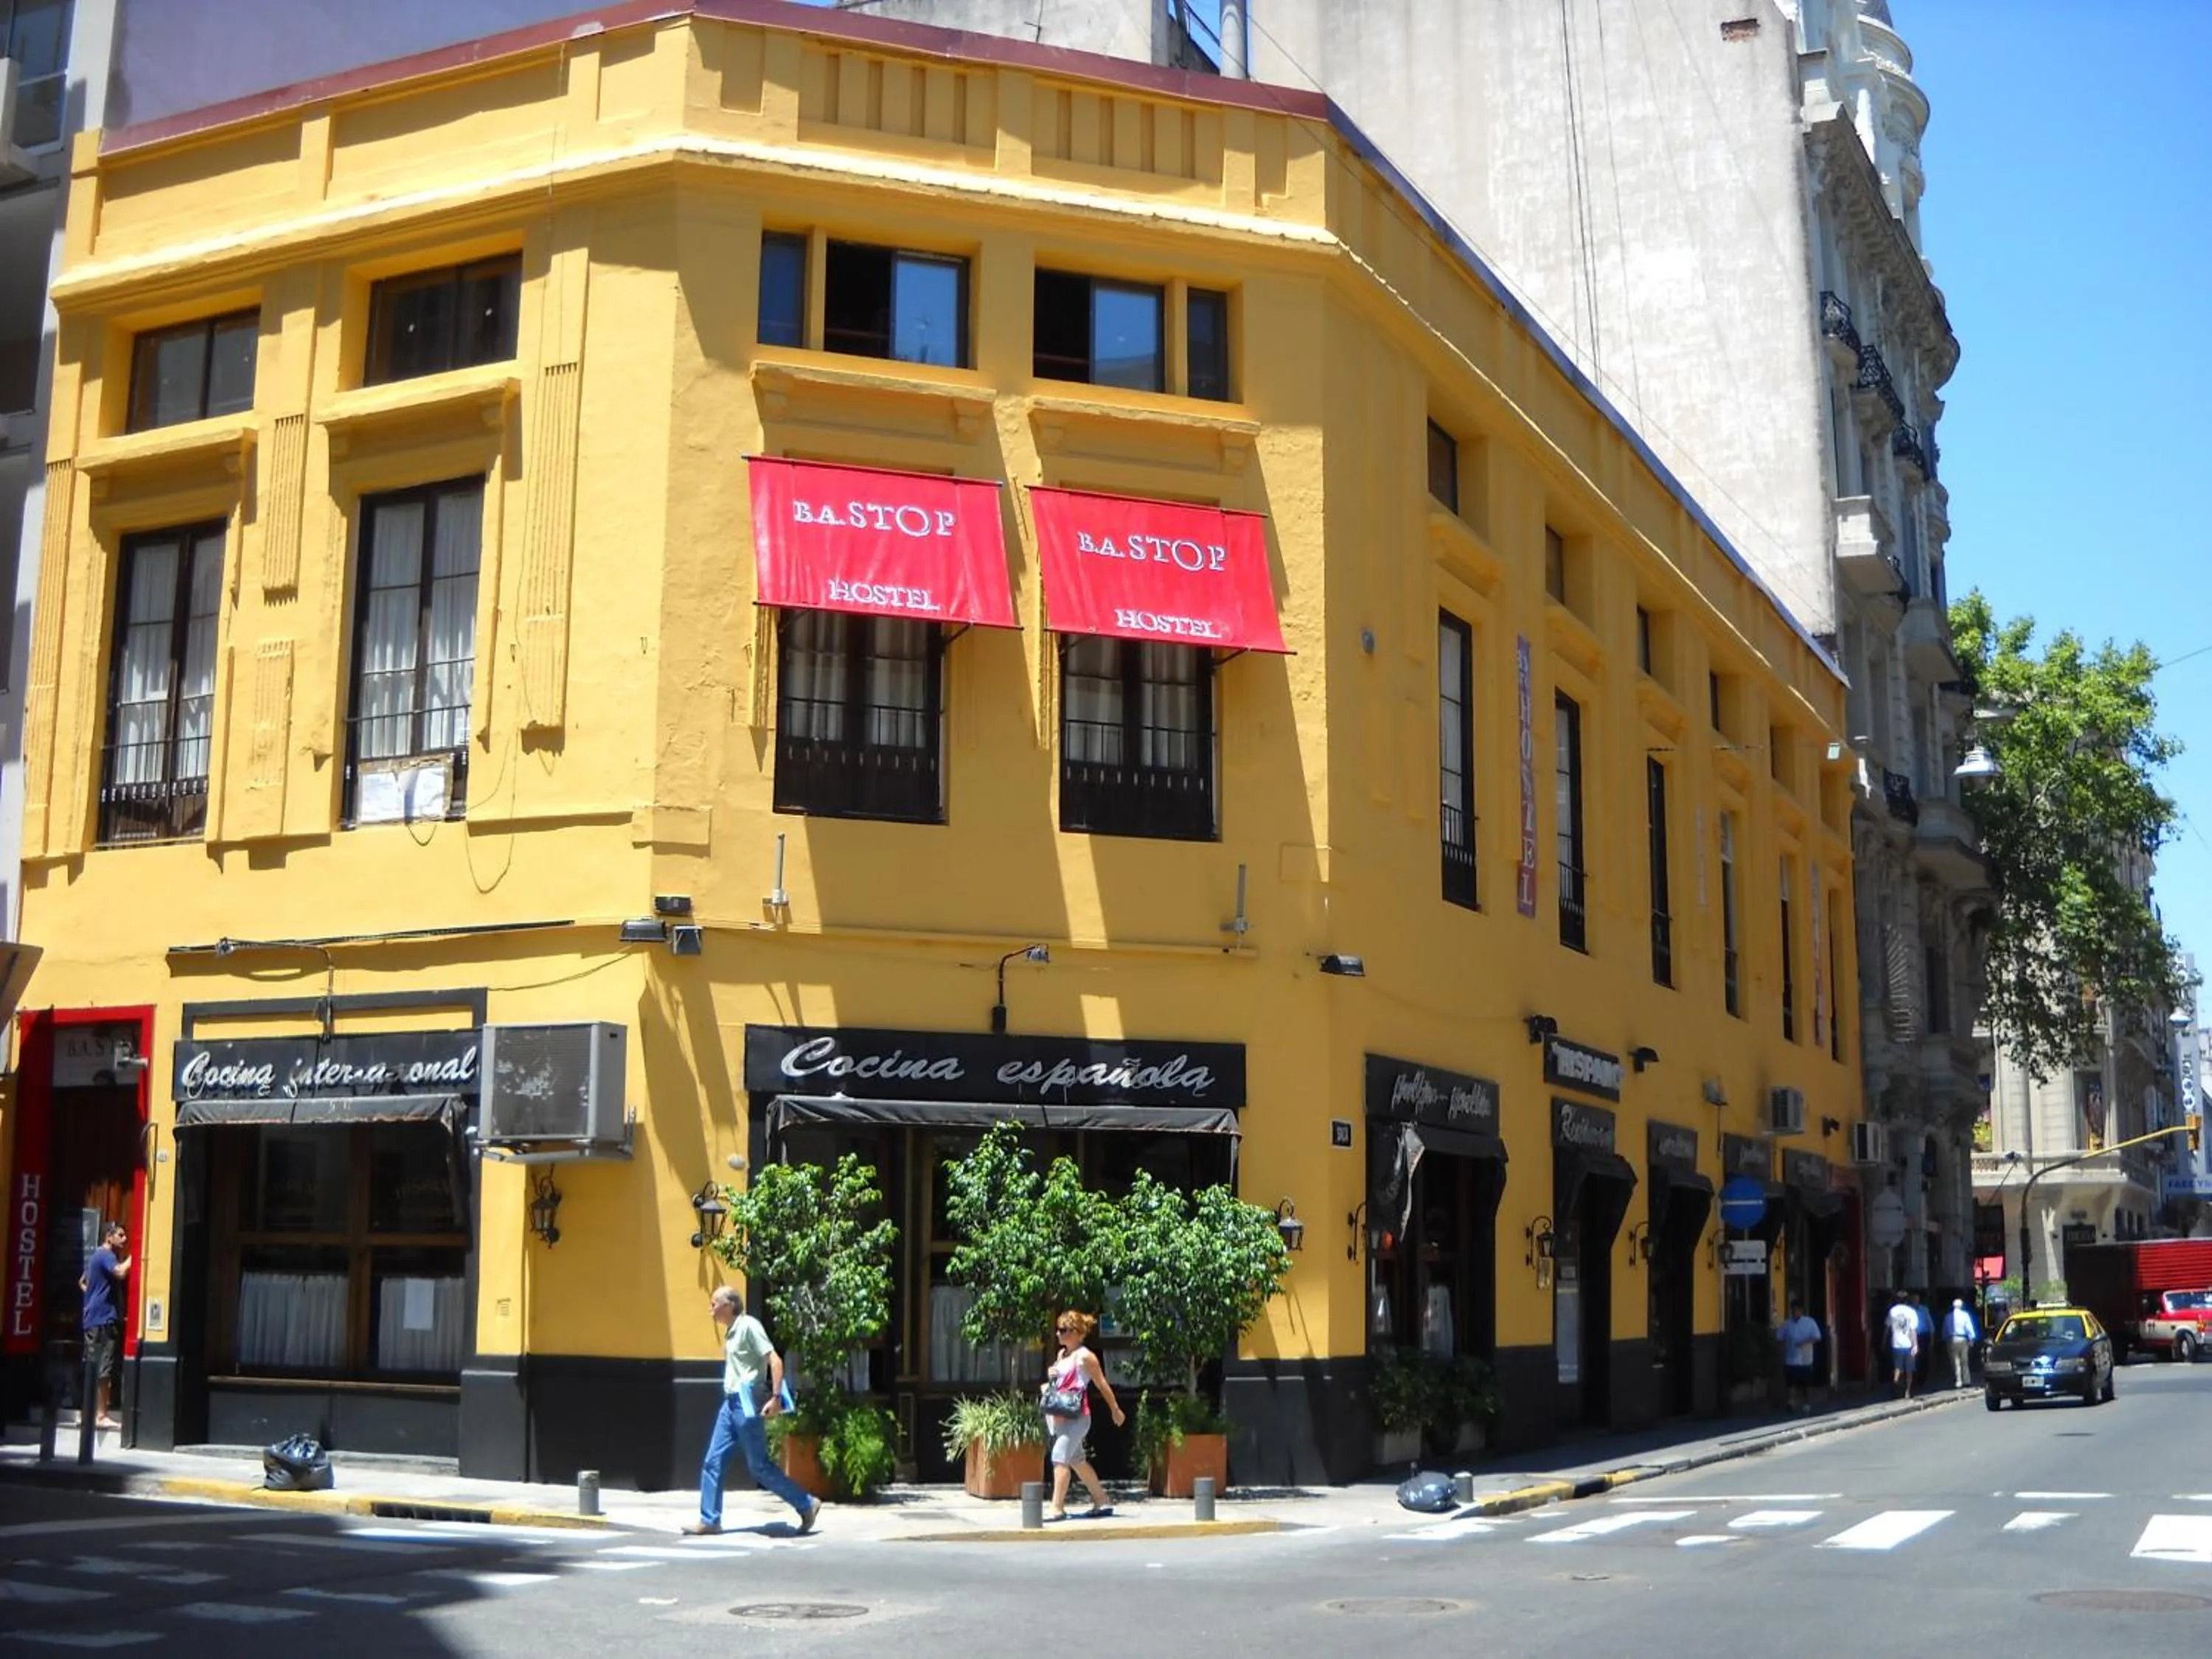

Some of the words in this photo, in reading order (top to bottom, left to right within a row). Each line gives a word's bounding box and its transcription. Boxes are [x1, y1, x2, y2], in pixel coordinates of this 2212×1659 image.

[828, 577, 941, 611] HOSTEL
[1115, 608, 1222, 639] HOSTEL
[1520, 695, 1534, 906] HOSTEL
[182, 1051, 275, 1098] Cocina
[780, 1036, 964, 1079] Cocina
[997, 1054, 1217, 1097] española
[13, 1174, 40, 1335] HOSTEL
